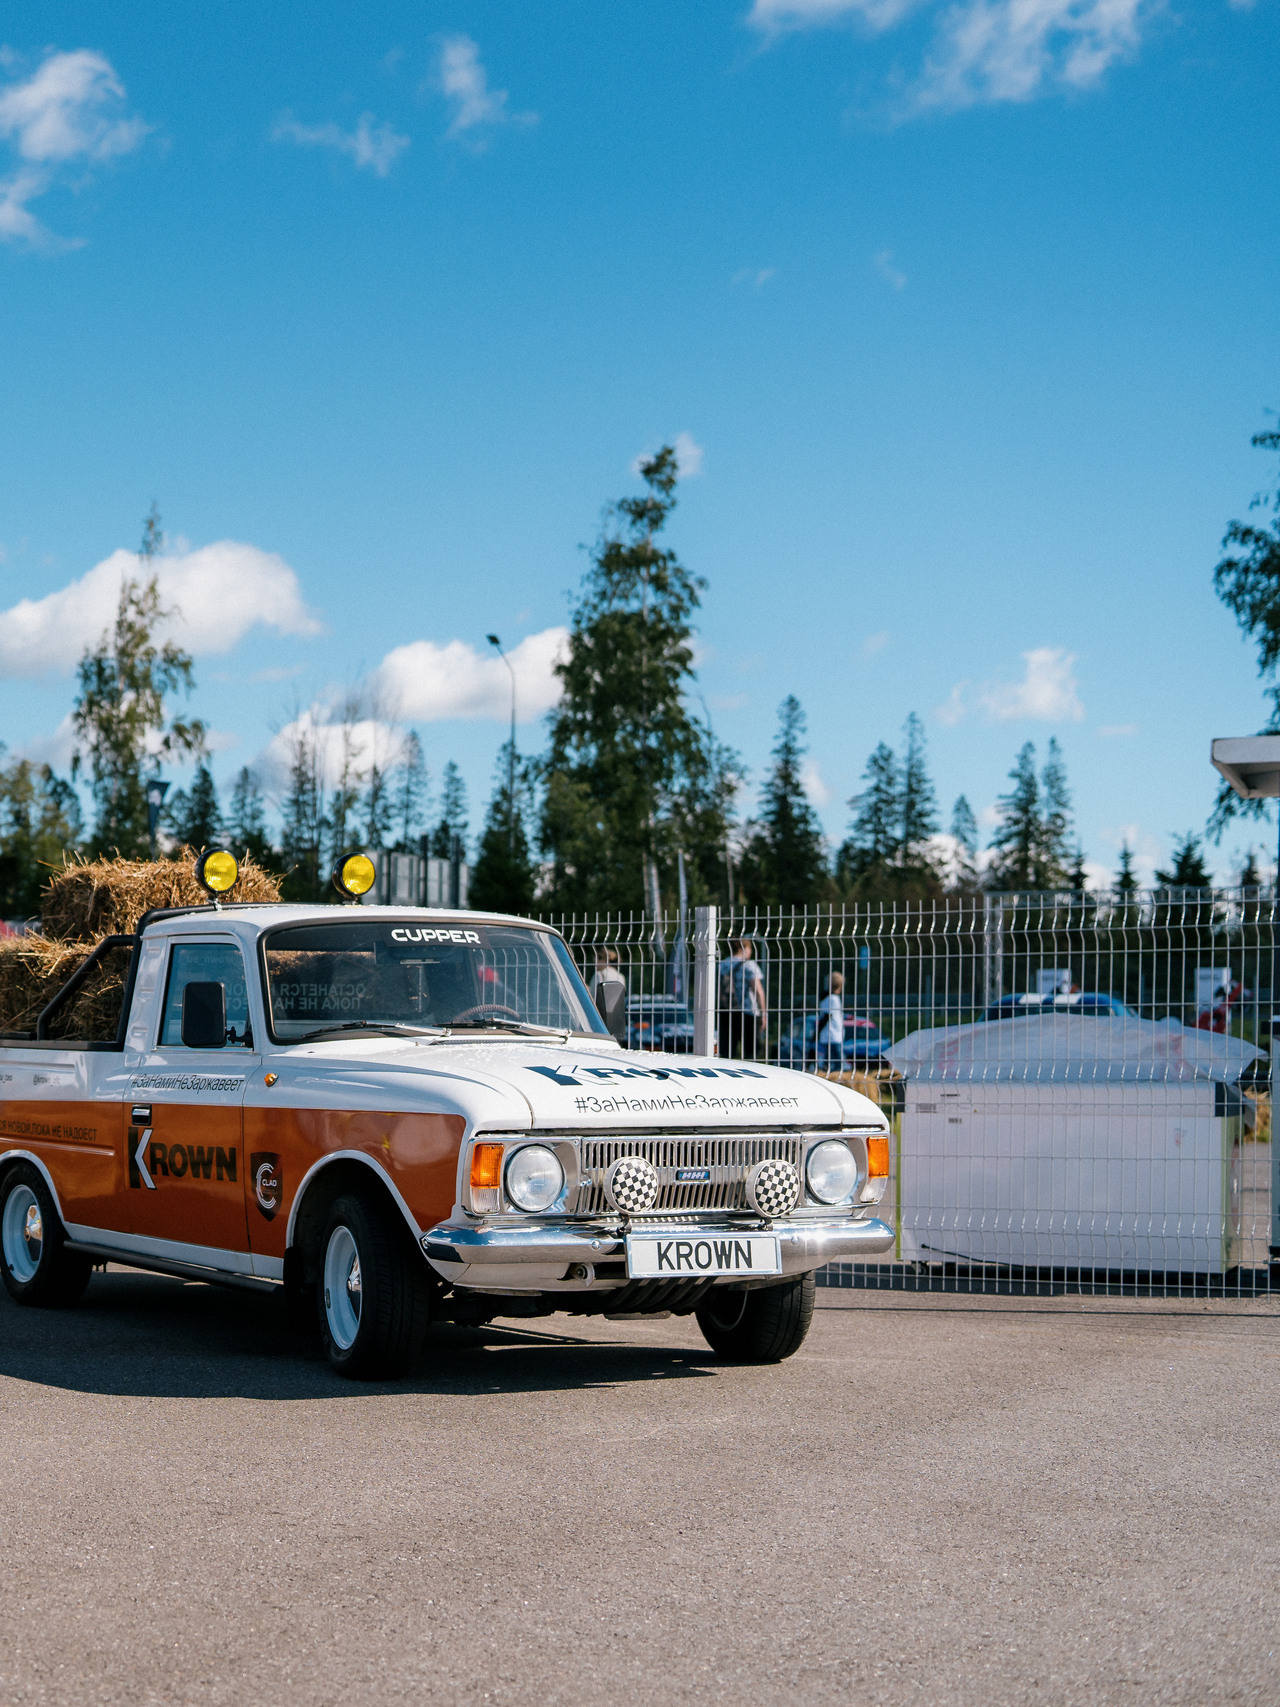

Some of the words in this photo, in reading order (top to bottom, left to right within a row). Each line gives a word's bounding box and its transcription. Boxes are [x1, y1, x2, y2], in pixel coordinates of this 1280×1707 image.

[391, 928, 481, 944] CUPPER
[131, 1073, 245, 1094] #ЗаНамиНеЗаржавеет
[128, 1126, 238, 1190] KROWN
[262, 1178, 278, 1188] CLAD
[656, 1240, 753, 1271] KROWN
